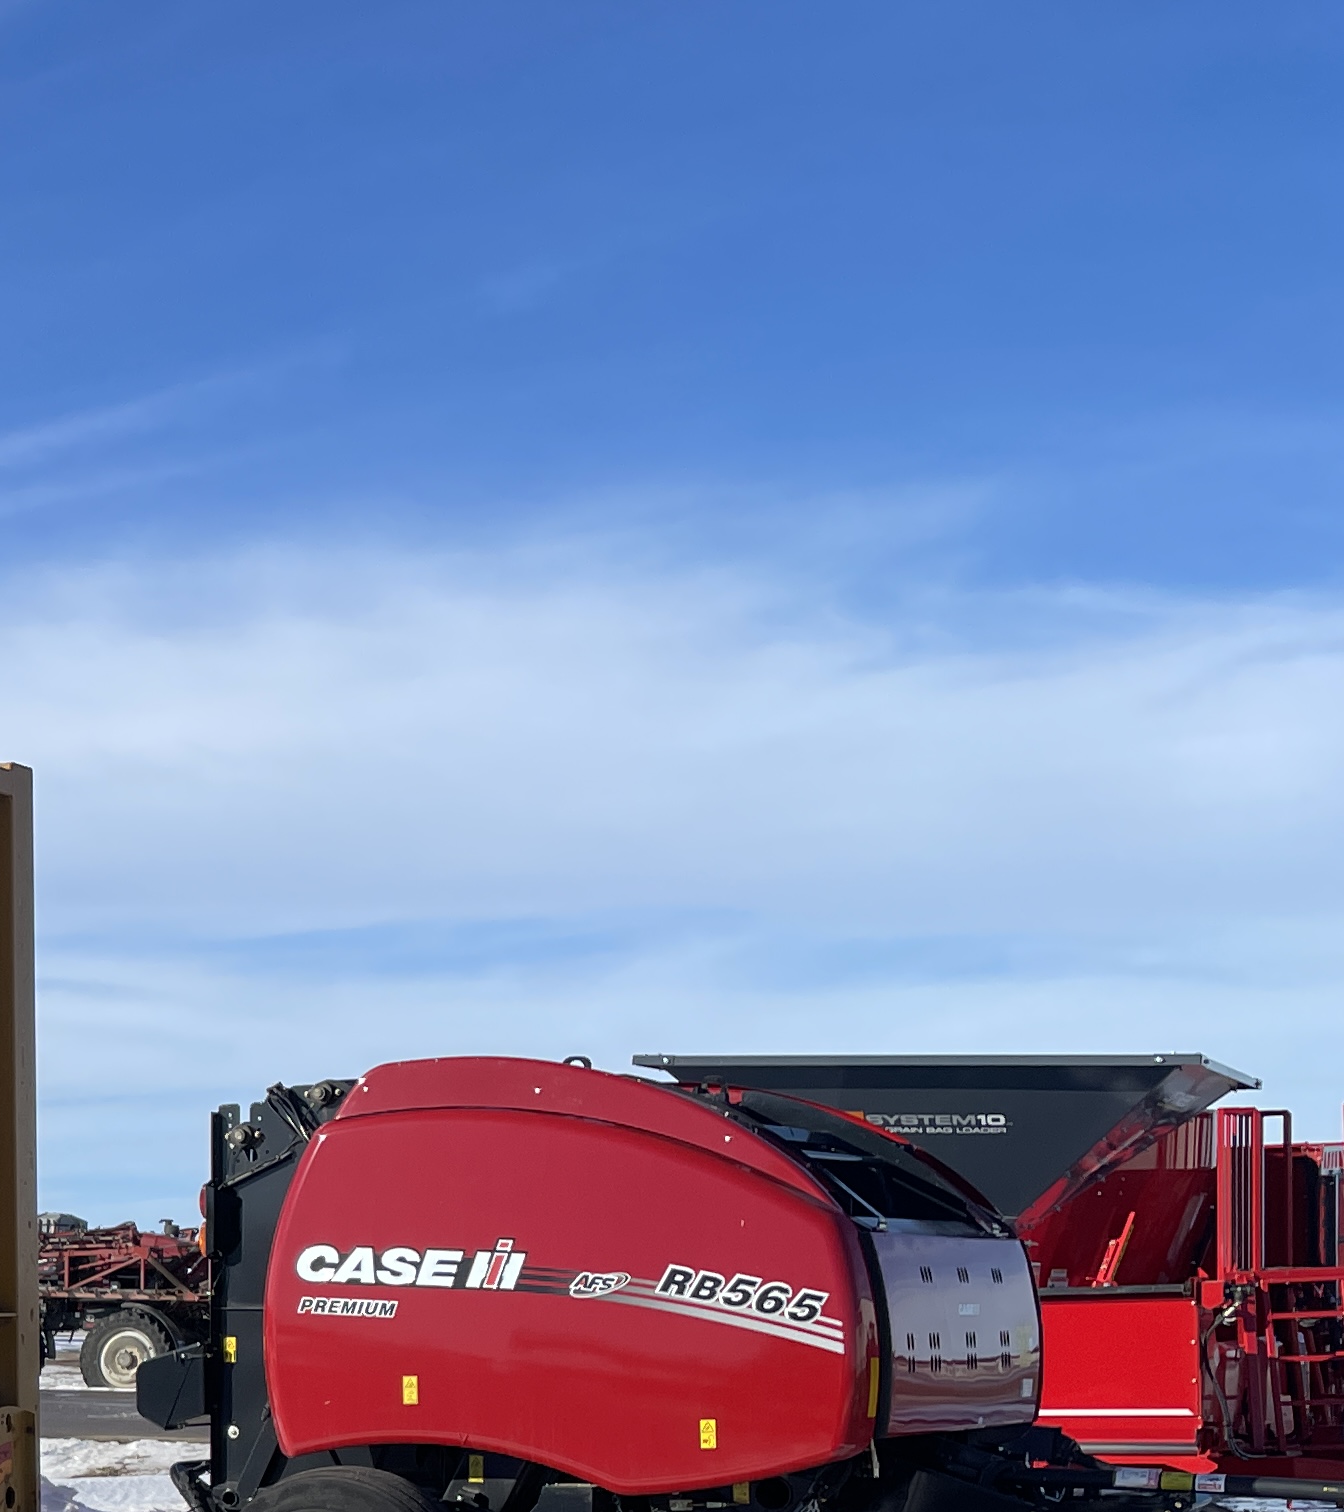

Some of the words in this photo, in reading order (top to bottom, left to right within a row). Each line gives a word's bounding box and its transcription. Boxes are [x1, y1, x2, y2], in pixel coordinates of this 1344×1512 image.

[297, 1244, 464, 1288] CASE
[570, 1273, 618, 1292] AFS
[656, 1264, 829, 1323] RB565
[298, 1298, 398, 1318] PREMIUM
